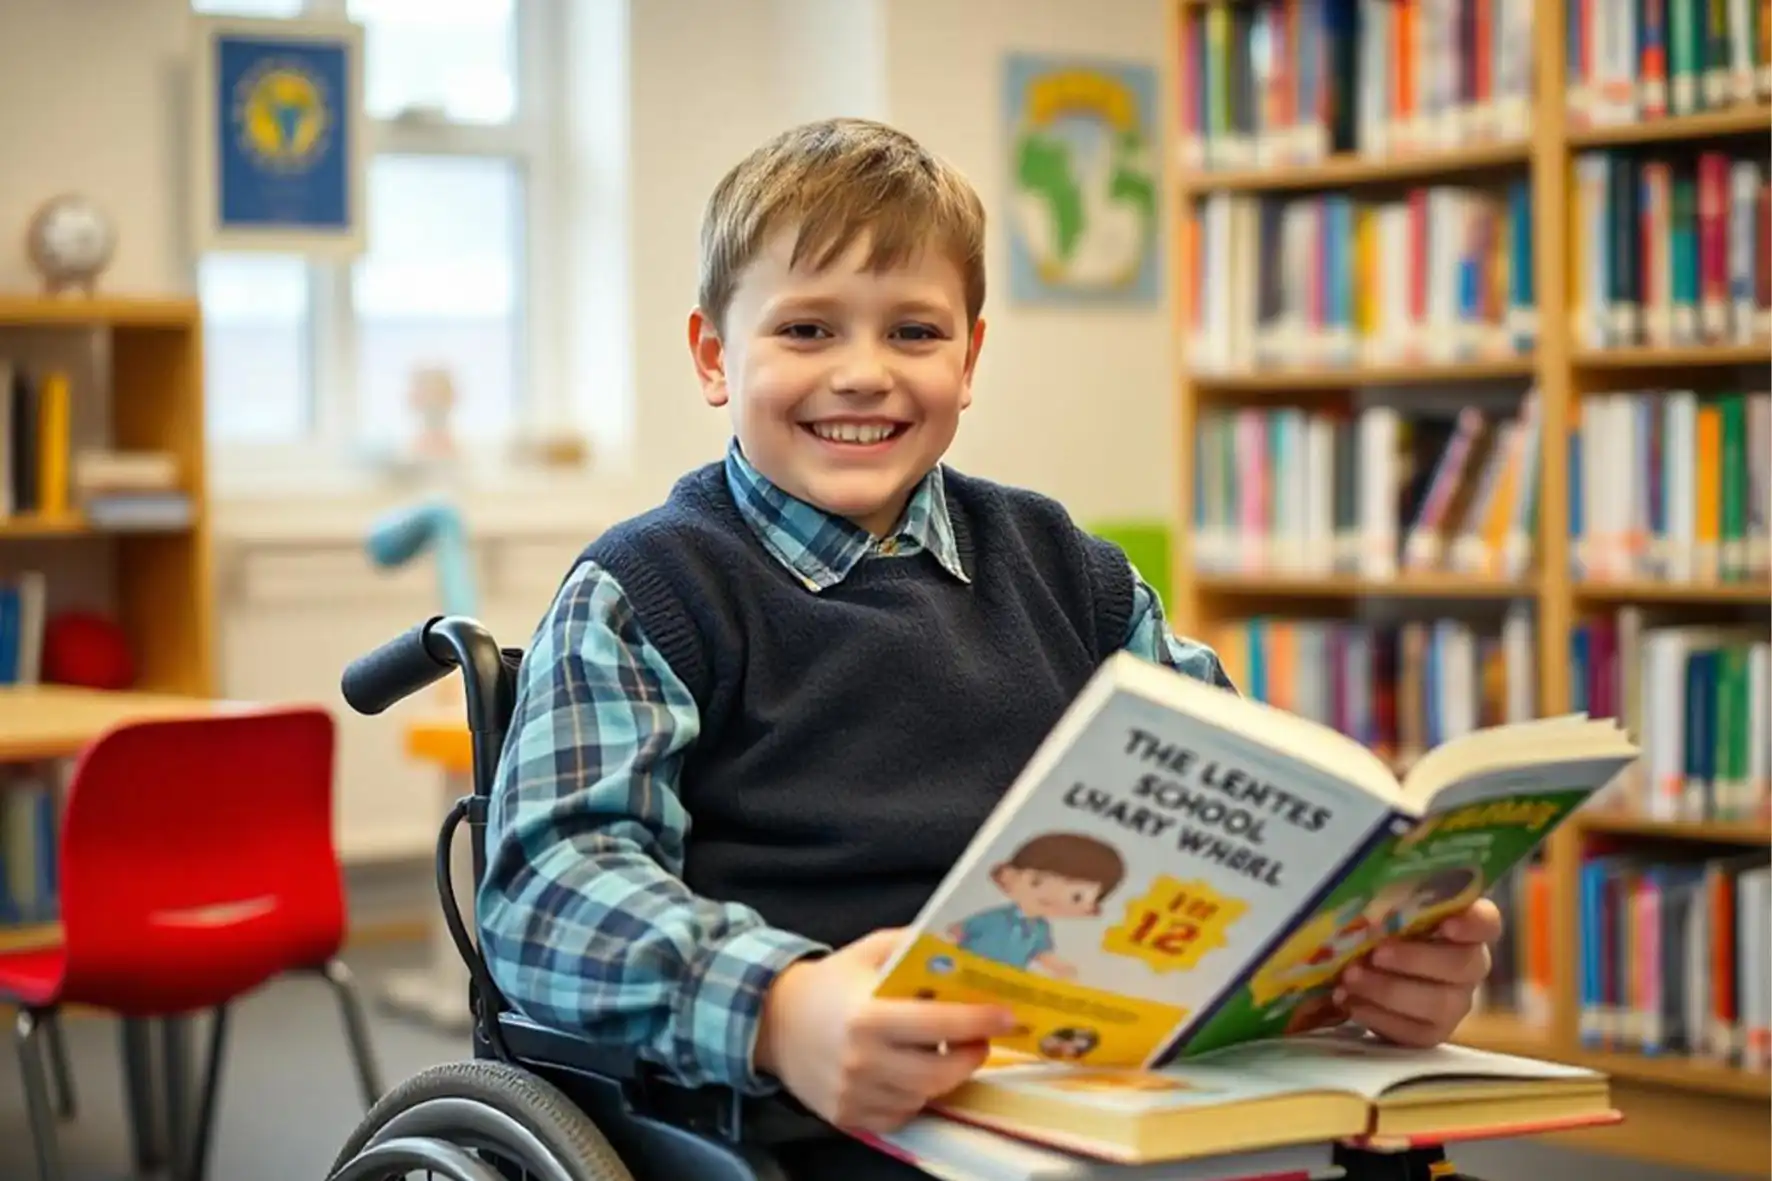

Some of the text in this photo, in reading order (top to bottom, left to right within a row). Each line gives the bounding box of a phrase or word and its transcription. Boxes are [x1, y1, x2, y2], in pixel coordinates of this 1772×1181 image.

[1124, 727, 1198, 775] THE
[1132, 773, 1266, 845] SCHOOL
[1128, 909, 1201, 956] 12
